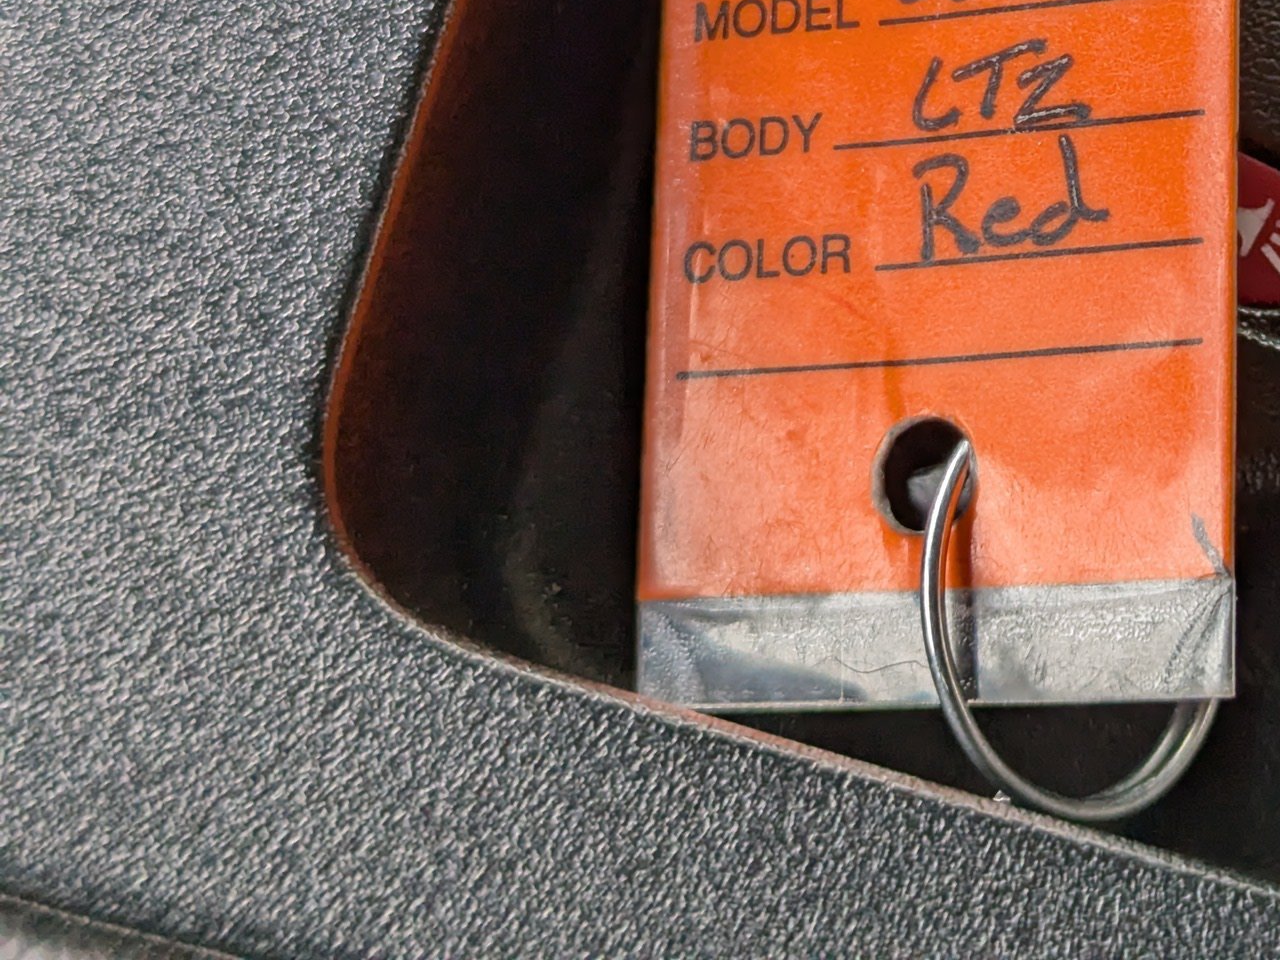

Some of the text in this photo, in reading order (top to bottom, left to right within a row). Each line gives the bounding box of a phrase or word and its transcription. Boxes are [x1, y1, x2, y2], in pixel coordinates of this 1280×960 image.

[689, 112, 823, 163] BODY
[912, 134, 1110, 265] Red
[683, 234, 852, 285] COLOR
